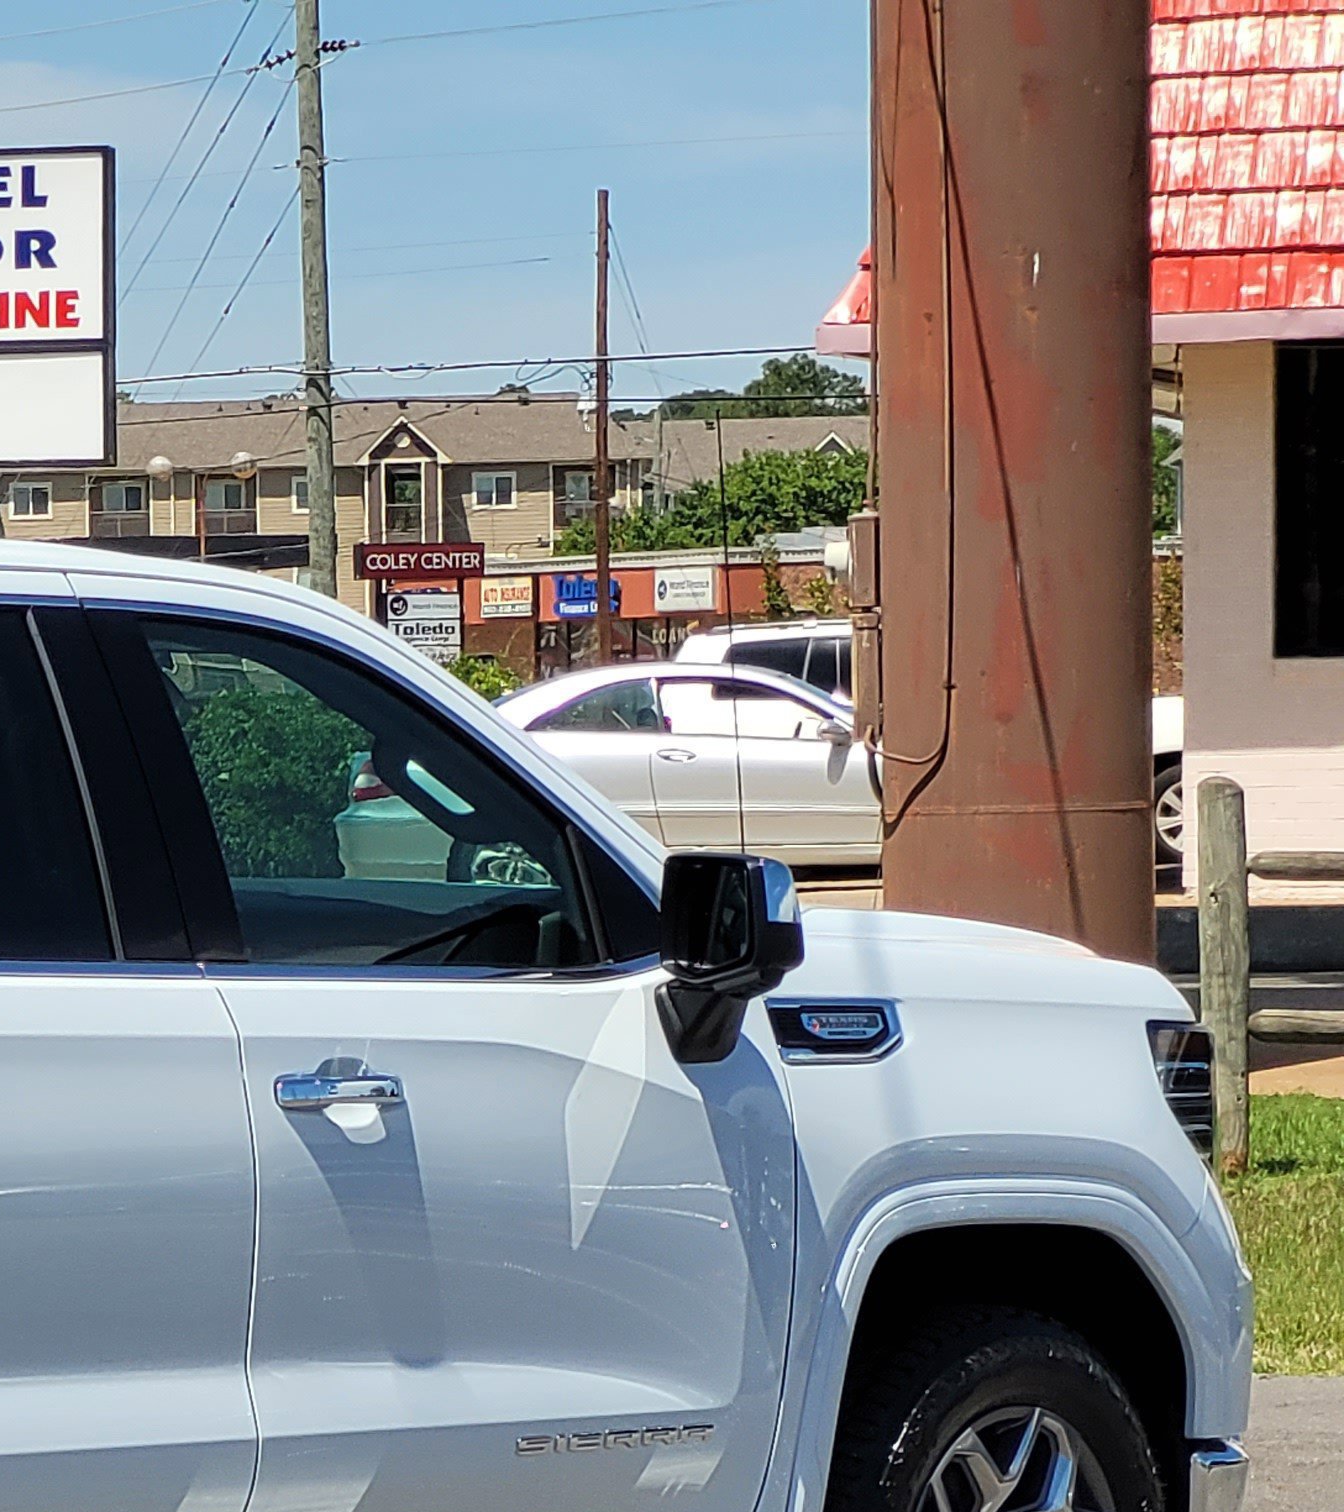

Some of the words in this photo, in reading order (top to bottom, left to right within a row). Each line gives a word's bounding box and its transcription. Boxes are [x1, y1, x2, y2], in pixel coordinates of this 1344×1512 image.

[366, 553, 418, 570] COLEY
[421, 552, 480, 569] CENTER
[392, 622, 455, 636] Toledo
[515, 1424, 714, 1457] SIERRA
